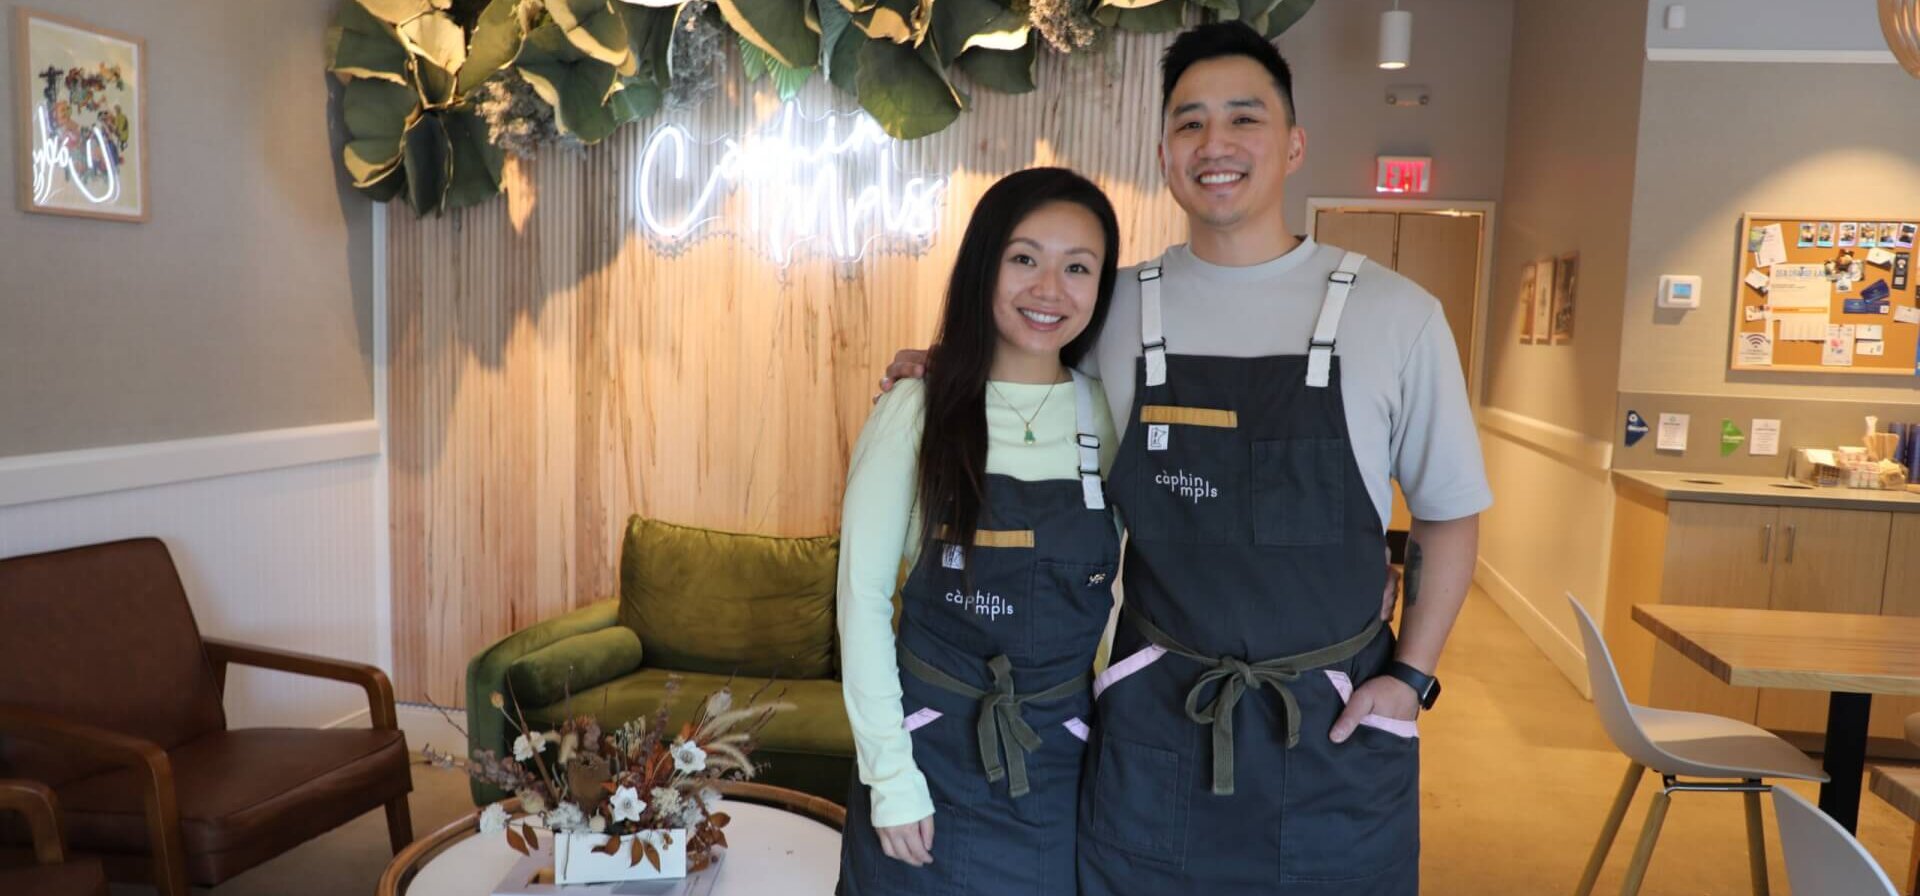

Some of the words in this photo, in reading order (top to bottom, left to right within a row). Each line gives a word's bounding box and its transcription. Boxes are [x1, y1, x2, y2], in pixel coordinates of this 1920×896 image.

[1386, 160, 1425, 191] EXIT
[1155, 468, 1204, 493] càphin
[1180, 480, 1218, 504] mpls
[945, 588, 1000, 611] càphin
[975, 598, 1014, 622] mpls
